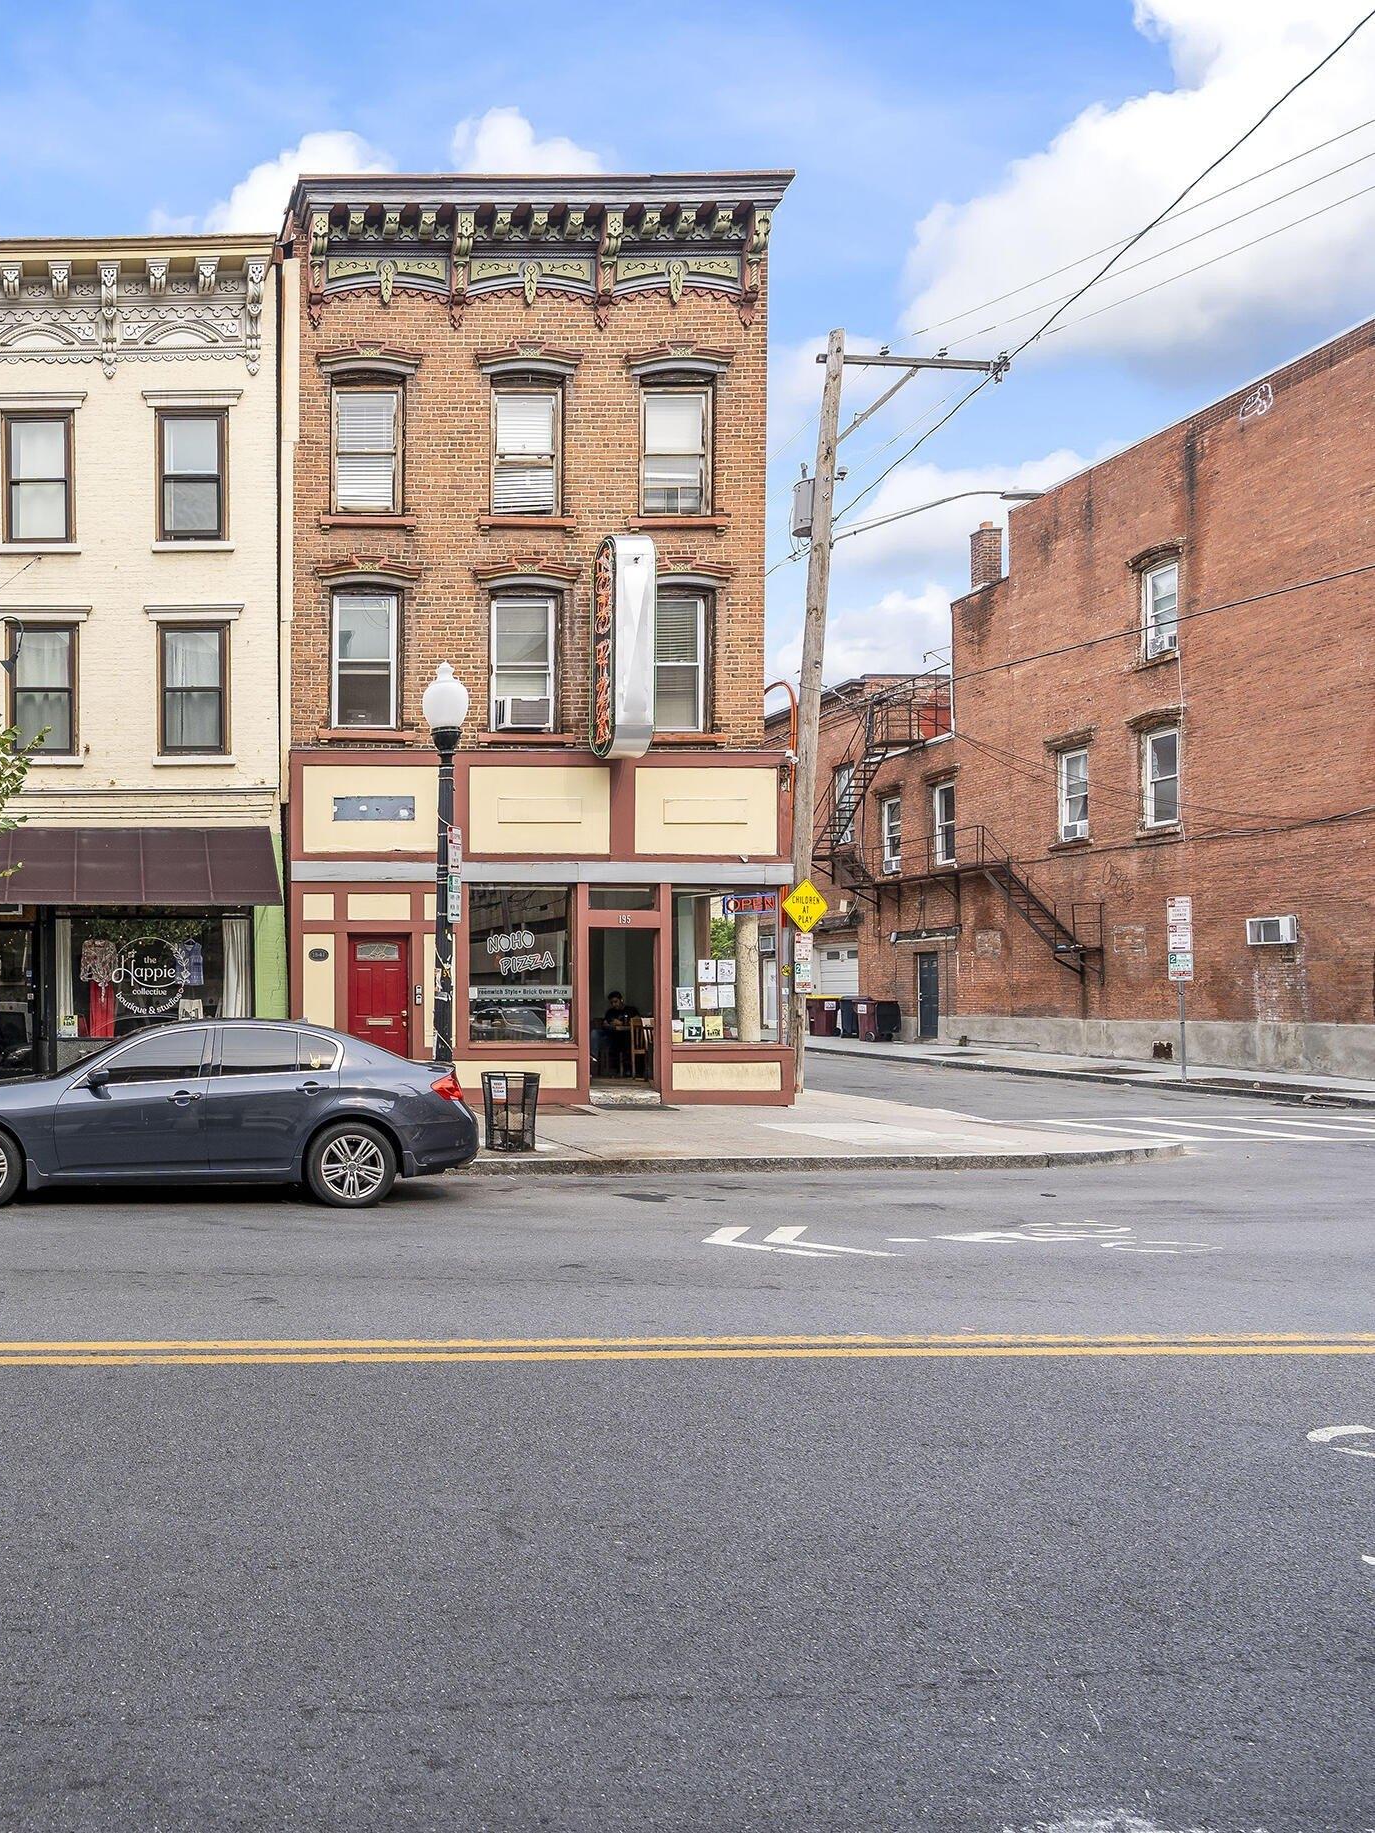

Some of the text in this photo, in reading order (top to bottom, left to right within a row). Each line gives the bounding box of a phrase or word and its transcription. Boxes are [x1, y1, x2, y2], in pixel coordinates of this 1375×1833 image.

[726, 896, 775, 912] OPEN
[791, 895, 820, 905] CHILDREN
[802, 905, 810, 914] AT
[618, 914, 632, 924] 195
[797, 914, 813, 924] PLAY
[486, 930, 536, 955] NOHO
[143, 956, 157, 964] the
[498, 950, 556, 976] PIZZA
[112, 954, 176, 987] Happie
[132, 988, 168, 996] collective
[115, 991, 183, 1015] boutique & studios
